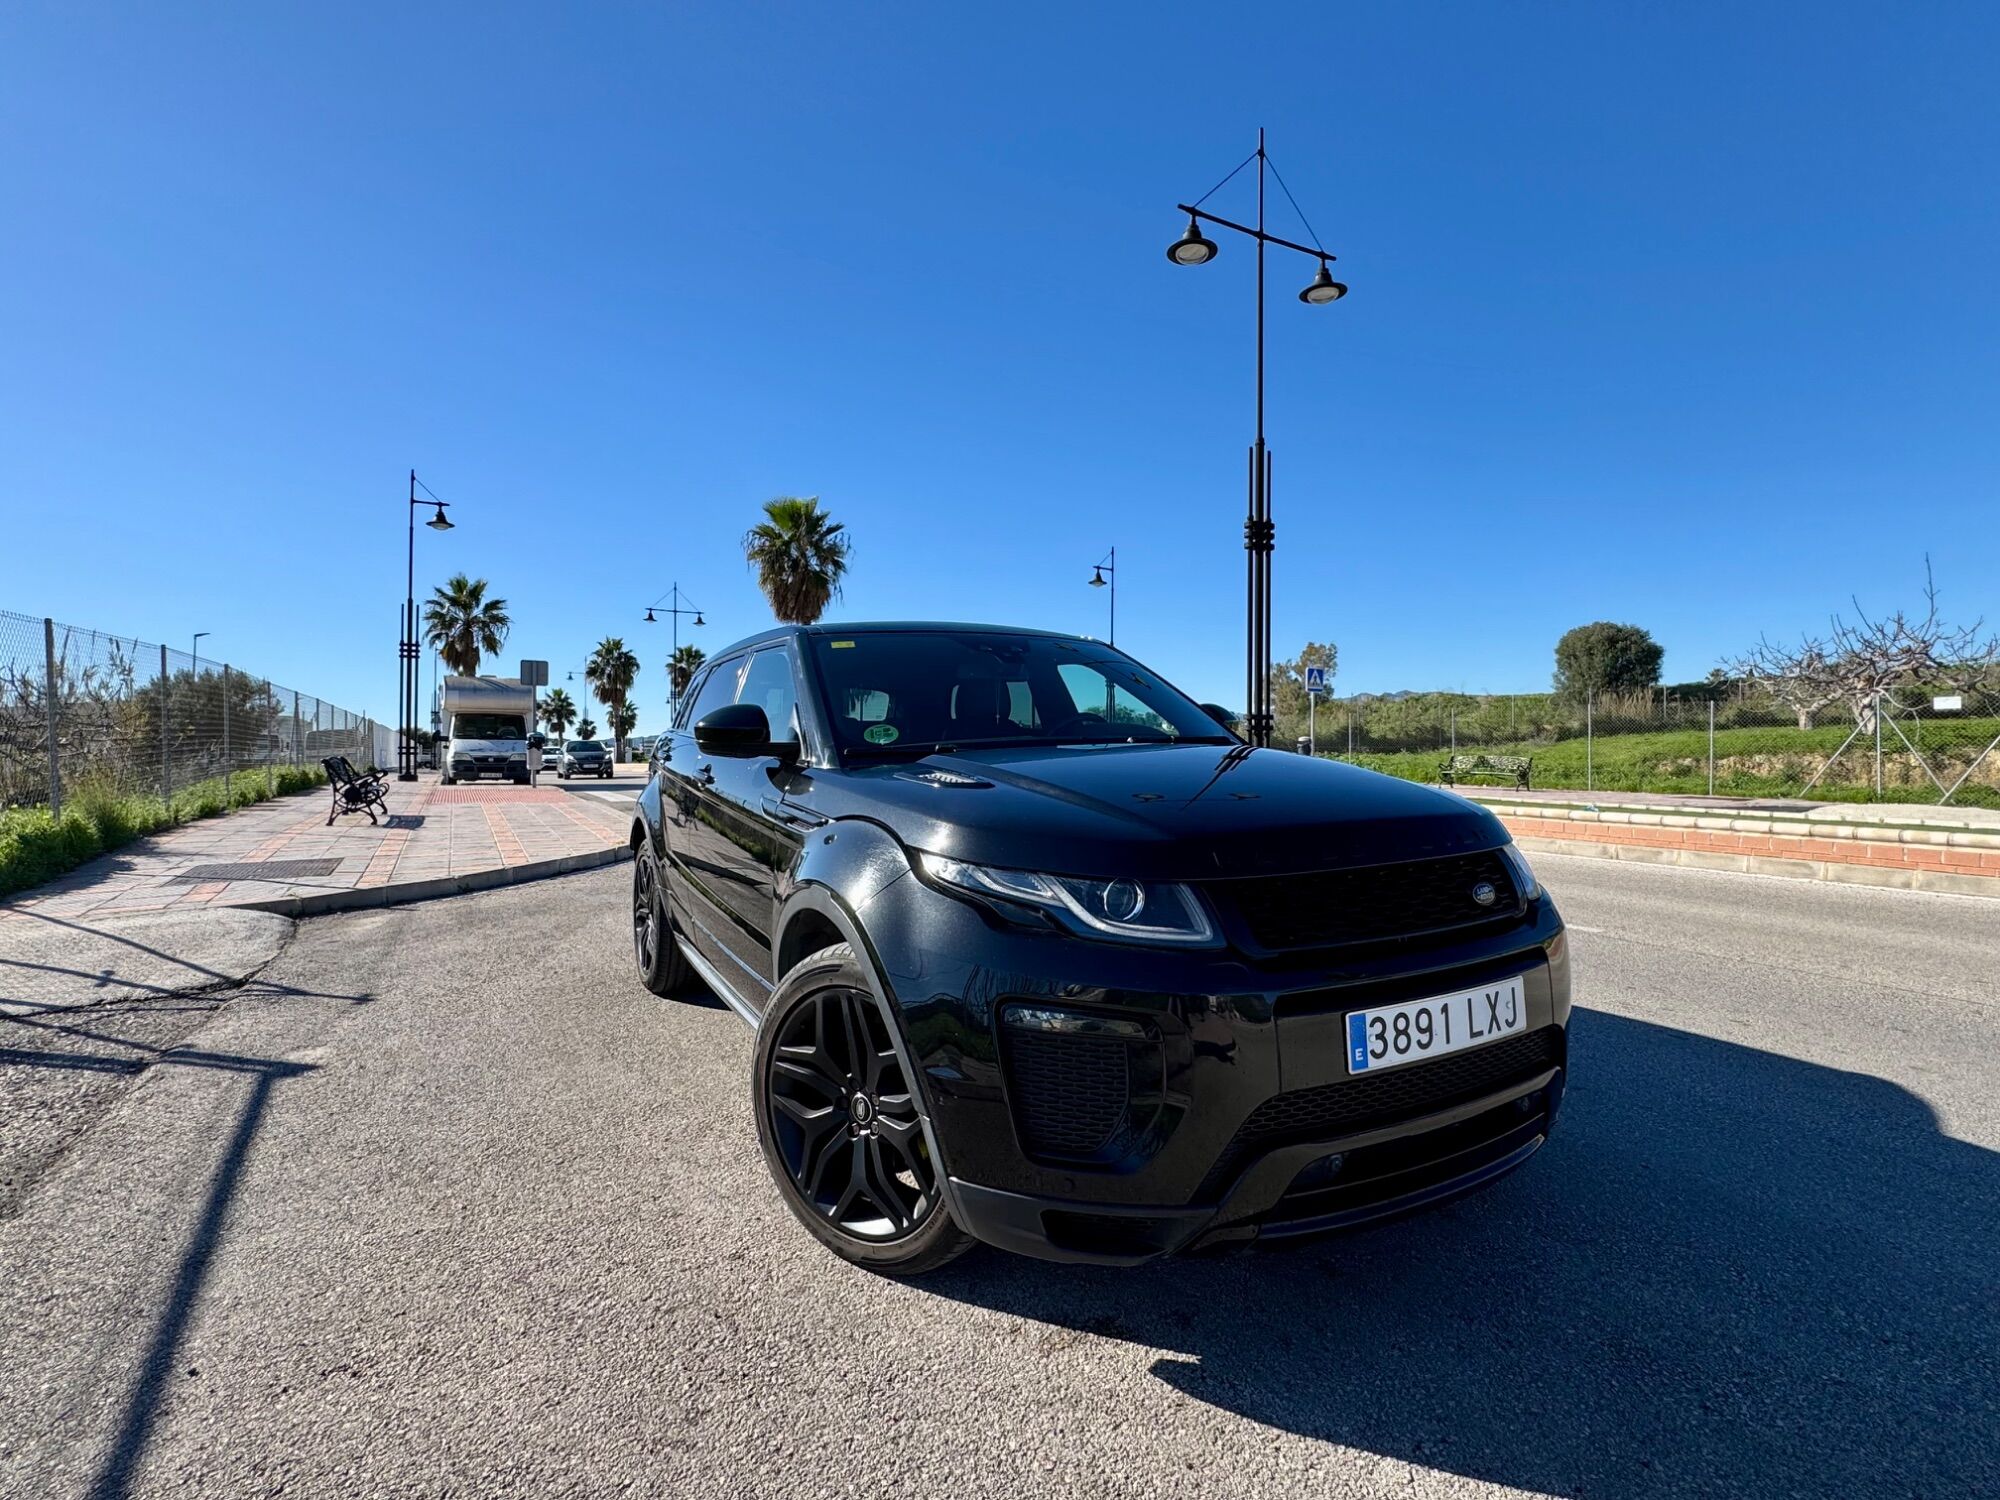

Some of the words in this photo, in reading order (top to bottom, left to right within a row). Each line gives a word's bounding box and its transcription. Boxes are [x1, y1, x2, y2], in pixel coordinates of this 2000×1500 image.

[1355, 1048, 1364, 1061] E
[1369, 1003, 1451, 1060] 3891
[1467, 987, 1518, 1039] LXJ
